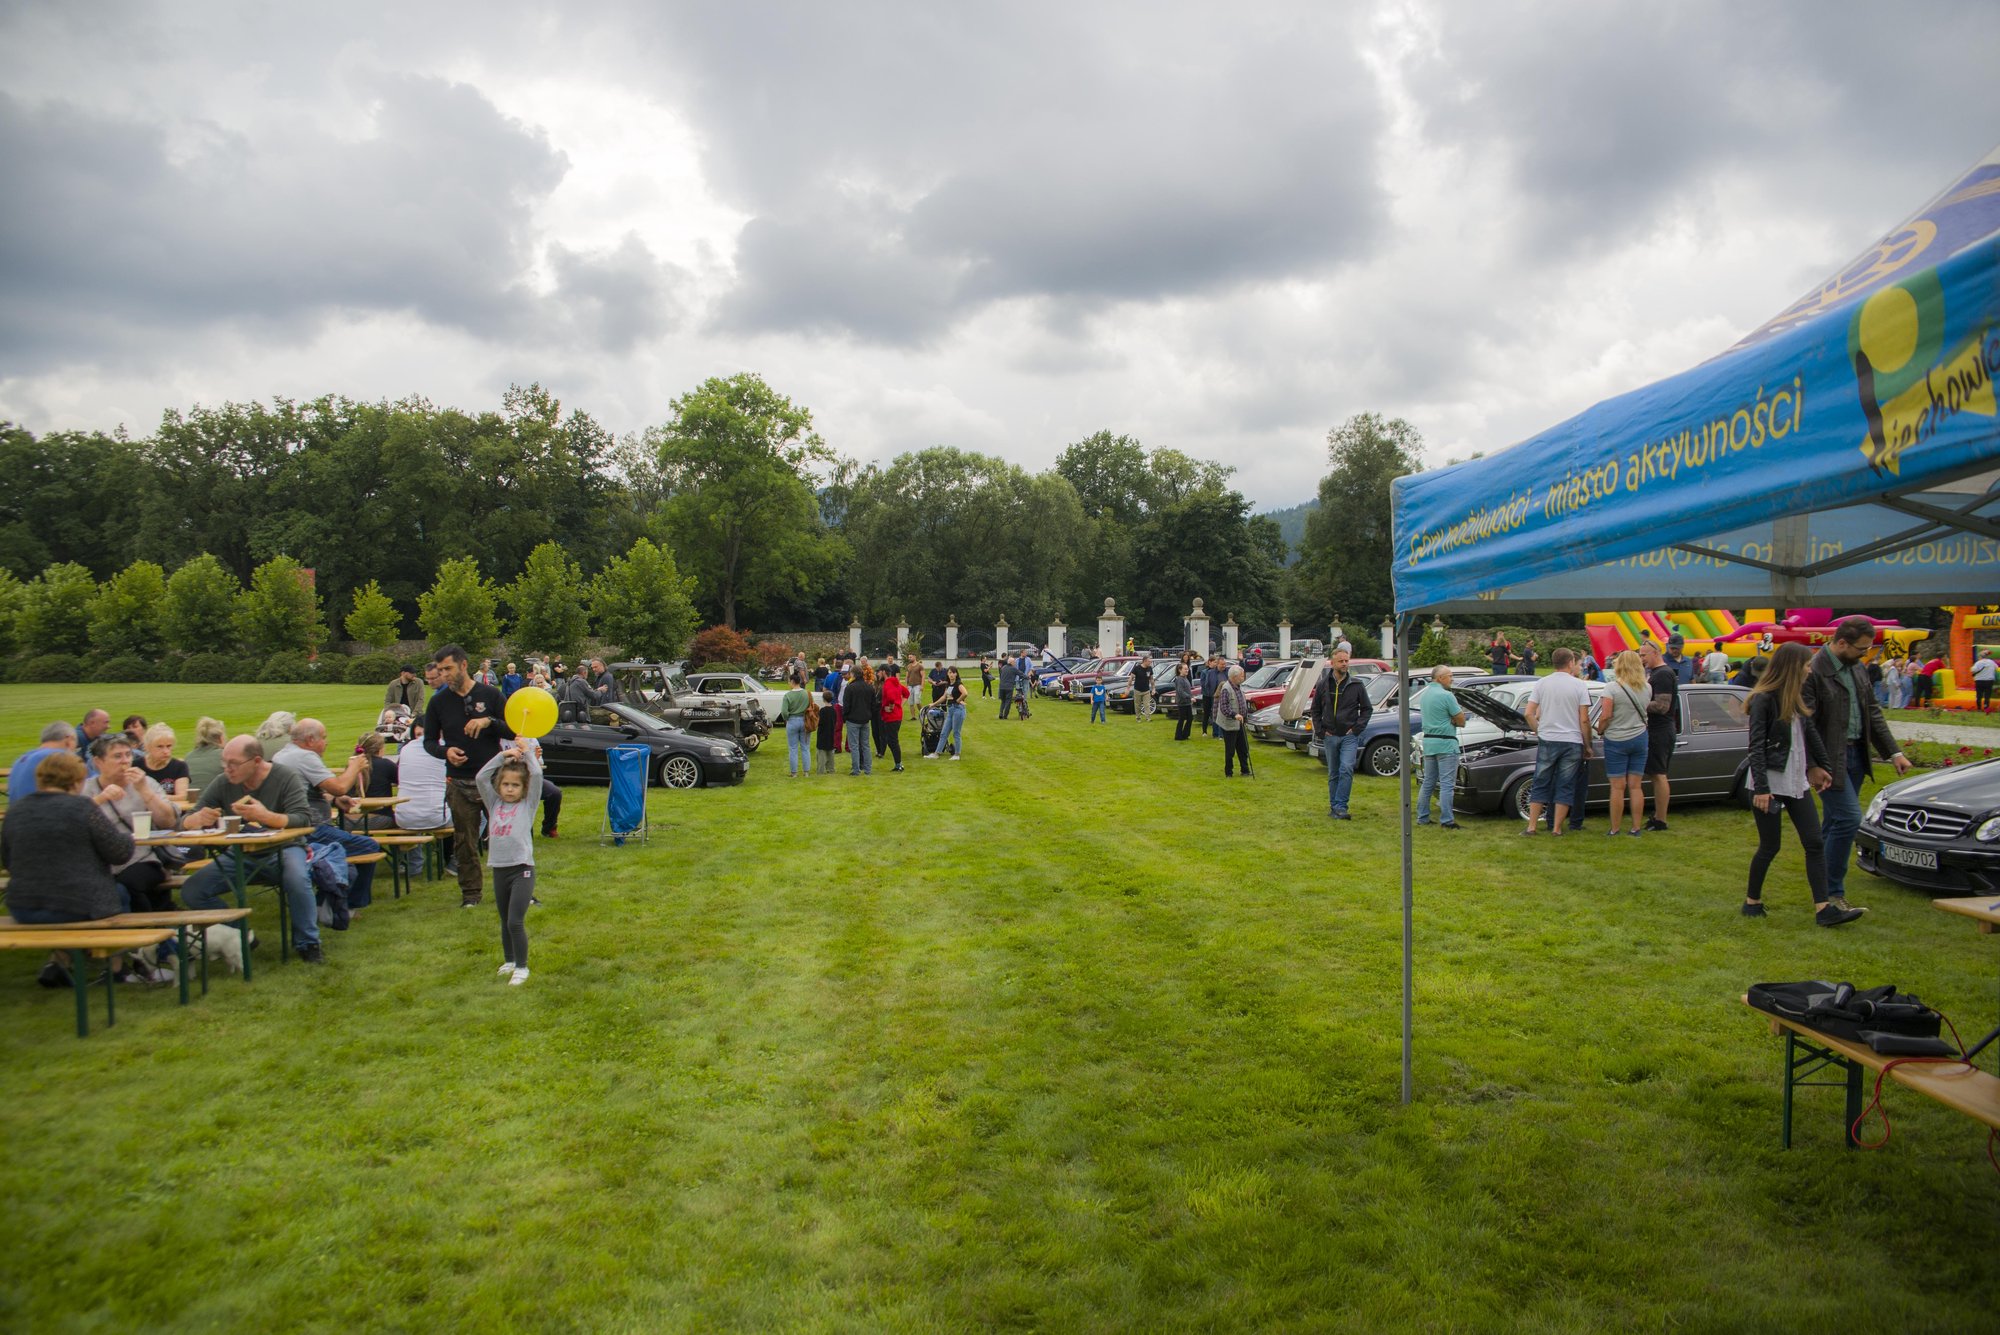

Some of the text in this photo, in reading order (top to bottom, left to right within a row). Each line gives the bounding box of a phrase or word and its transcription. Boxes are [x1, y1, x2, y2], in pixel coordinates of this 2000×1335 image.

[1442, 487, 1532, 554] możliwości
[1544, 471, 1619, 519] miasto
[1625, 376, 1801, 492] aktywności
[1901, 849, 1937, 868] 09702
